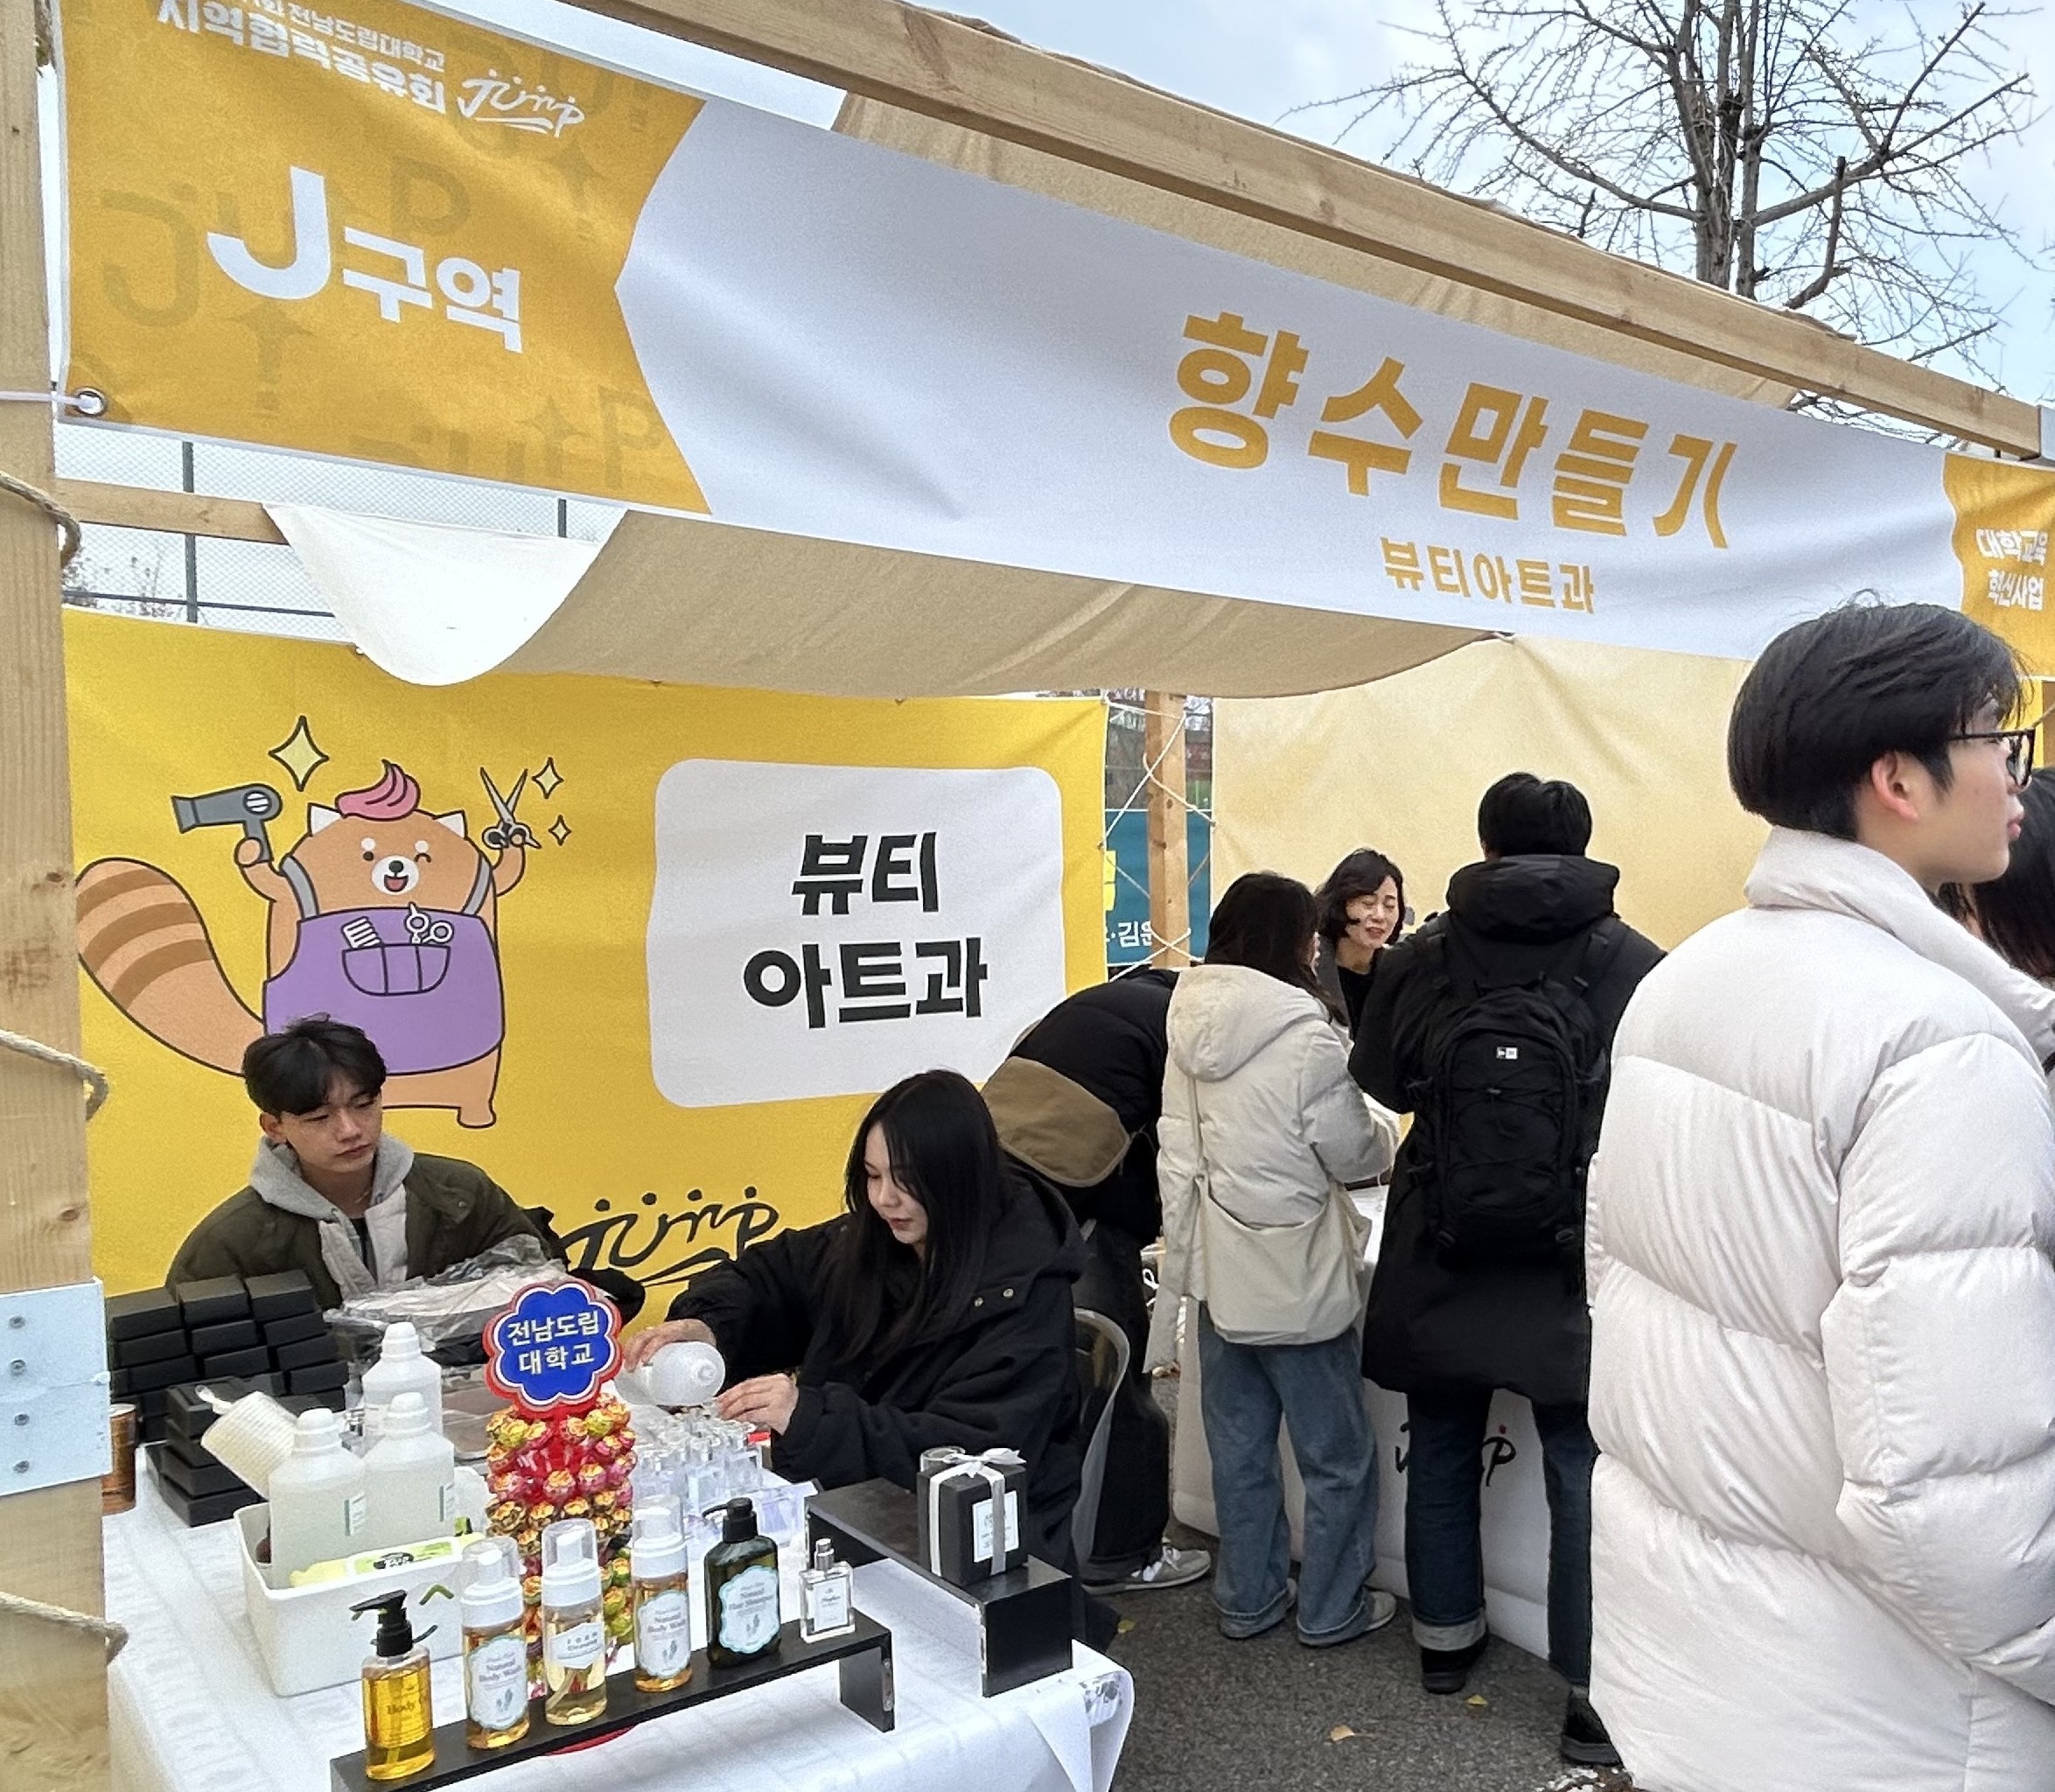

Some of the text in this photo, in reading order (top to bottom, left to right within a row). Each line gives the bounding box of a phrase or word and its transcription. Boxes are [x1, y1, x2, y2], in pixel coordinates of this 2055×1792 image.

[288, 3, 445, 73] 전남도립대학교
[207, 166, 524, 354] J구역
[1168, 311, 1737, 550] 향수만들기
[1380, 536, 1595, 614] 뷰티아트과
[792, 831, 940, 916] 뷰티
[744, 937, 988, 1029] 아트과
[507, 1310, 600, 1347] 전남도립
[518, 1342, 595, 1375] 대학교
